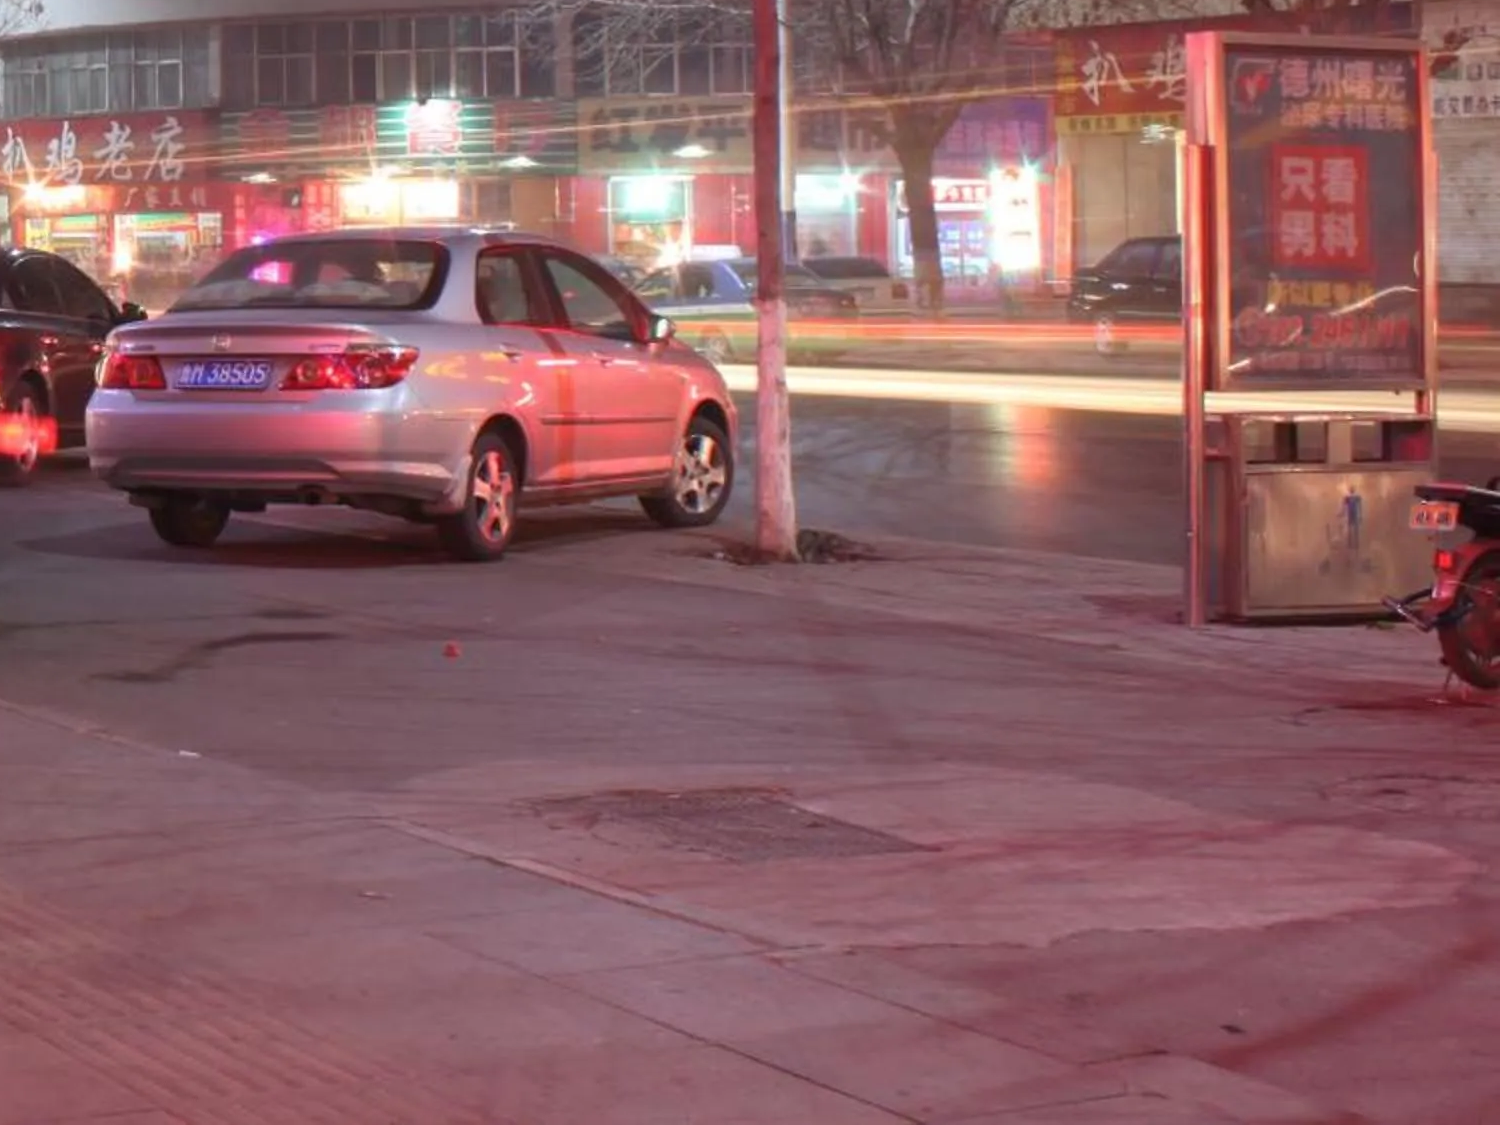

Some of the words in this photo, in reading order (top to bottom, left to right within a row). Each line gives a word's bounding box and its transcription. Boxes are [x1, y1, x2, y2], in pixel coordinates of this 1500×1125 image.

[2, 117, 186, 186] 扒鸡老店
[1280, 156, 1358, 204] 只看
[1280, 211, 1358, 259] 男科
